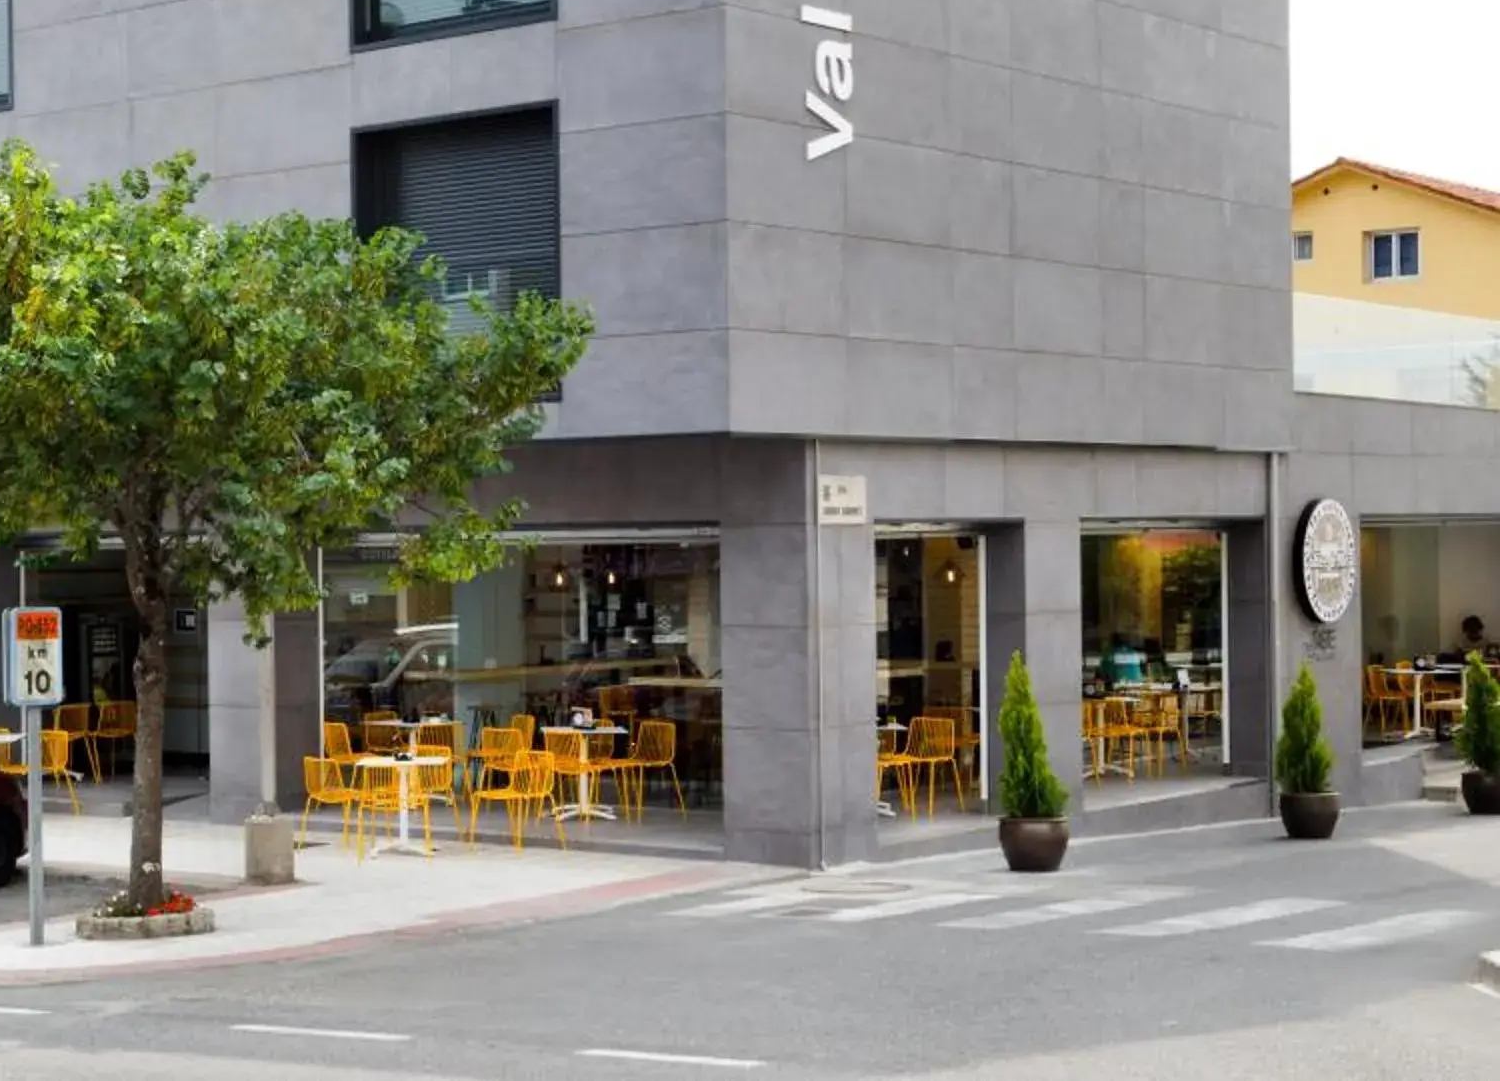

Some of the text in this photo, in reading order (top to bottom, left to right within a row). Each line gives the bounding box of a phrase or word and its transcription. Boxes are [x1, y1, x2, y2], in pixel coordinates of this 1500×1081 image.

[801, 4, 853, 161] Val
[27, 645, 49, 659] km
[24, 669, 51, 695] 10
